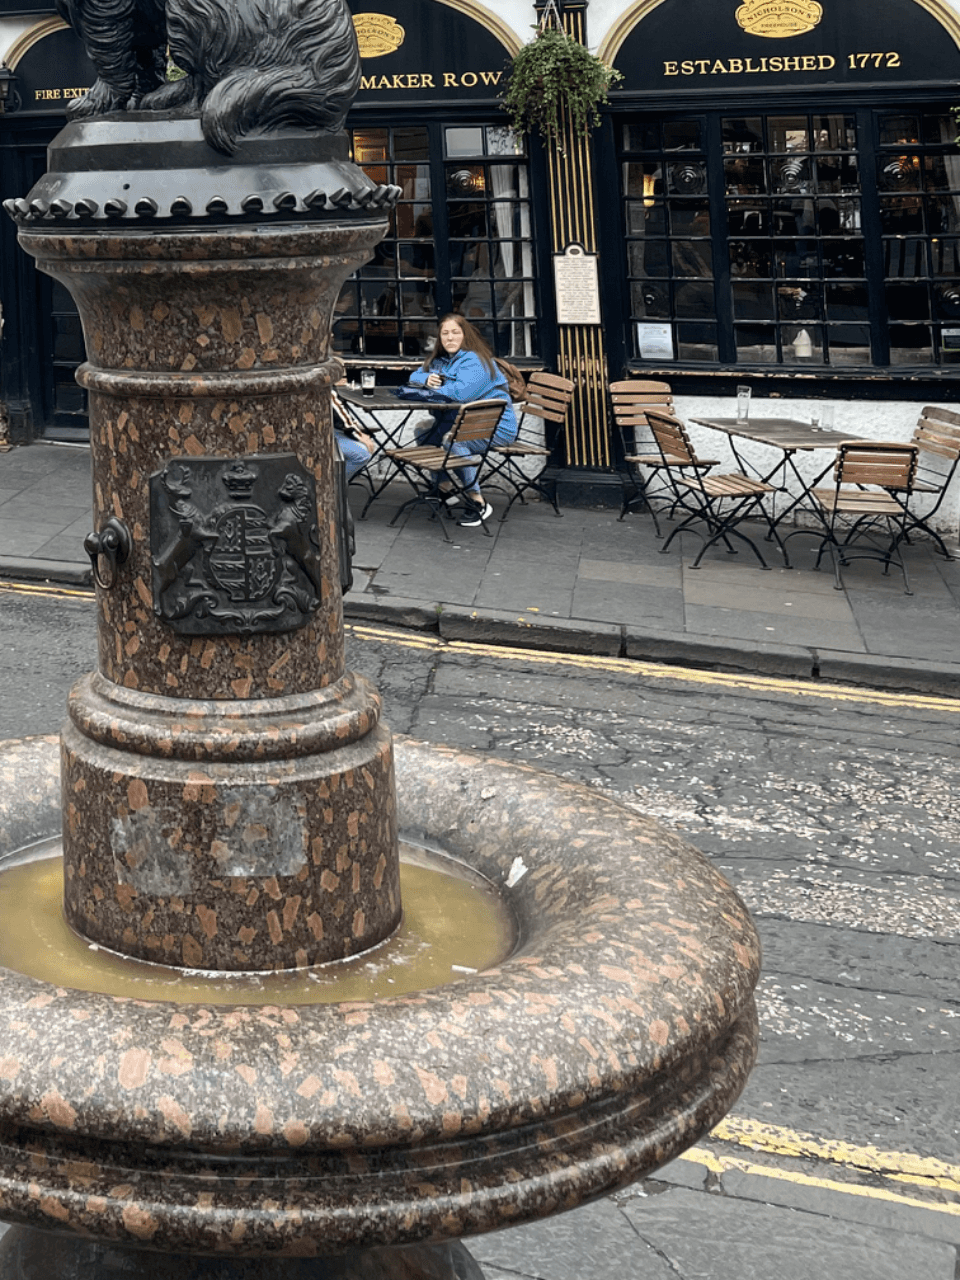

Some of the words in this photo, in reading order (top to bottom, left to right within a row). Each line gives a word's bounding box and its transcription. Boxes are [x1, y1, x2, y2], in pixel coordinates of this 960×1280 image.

[663, 55, 835, 75] ESTABLISHED
[848, 52, 901, 69] 1772
[359, 74, 435, 89] MAKER
[443, 72, 502, 87] ROW
[35, 89, 61, 100] FIRE
